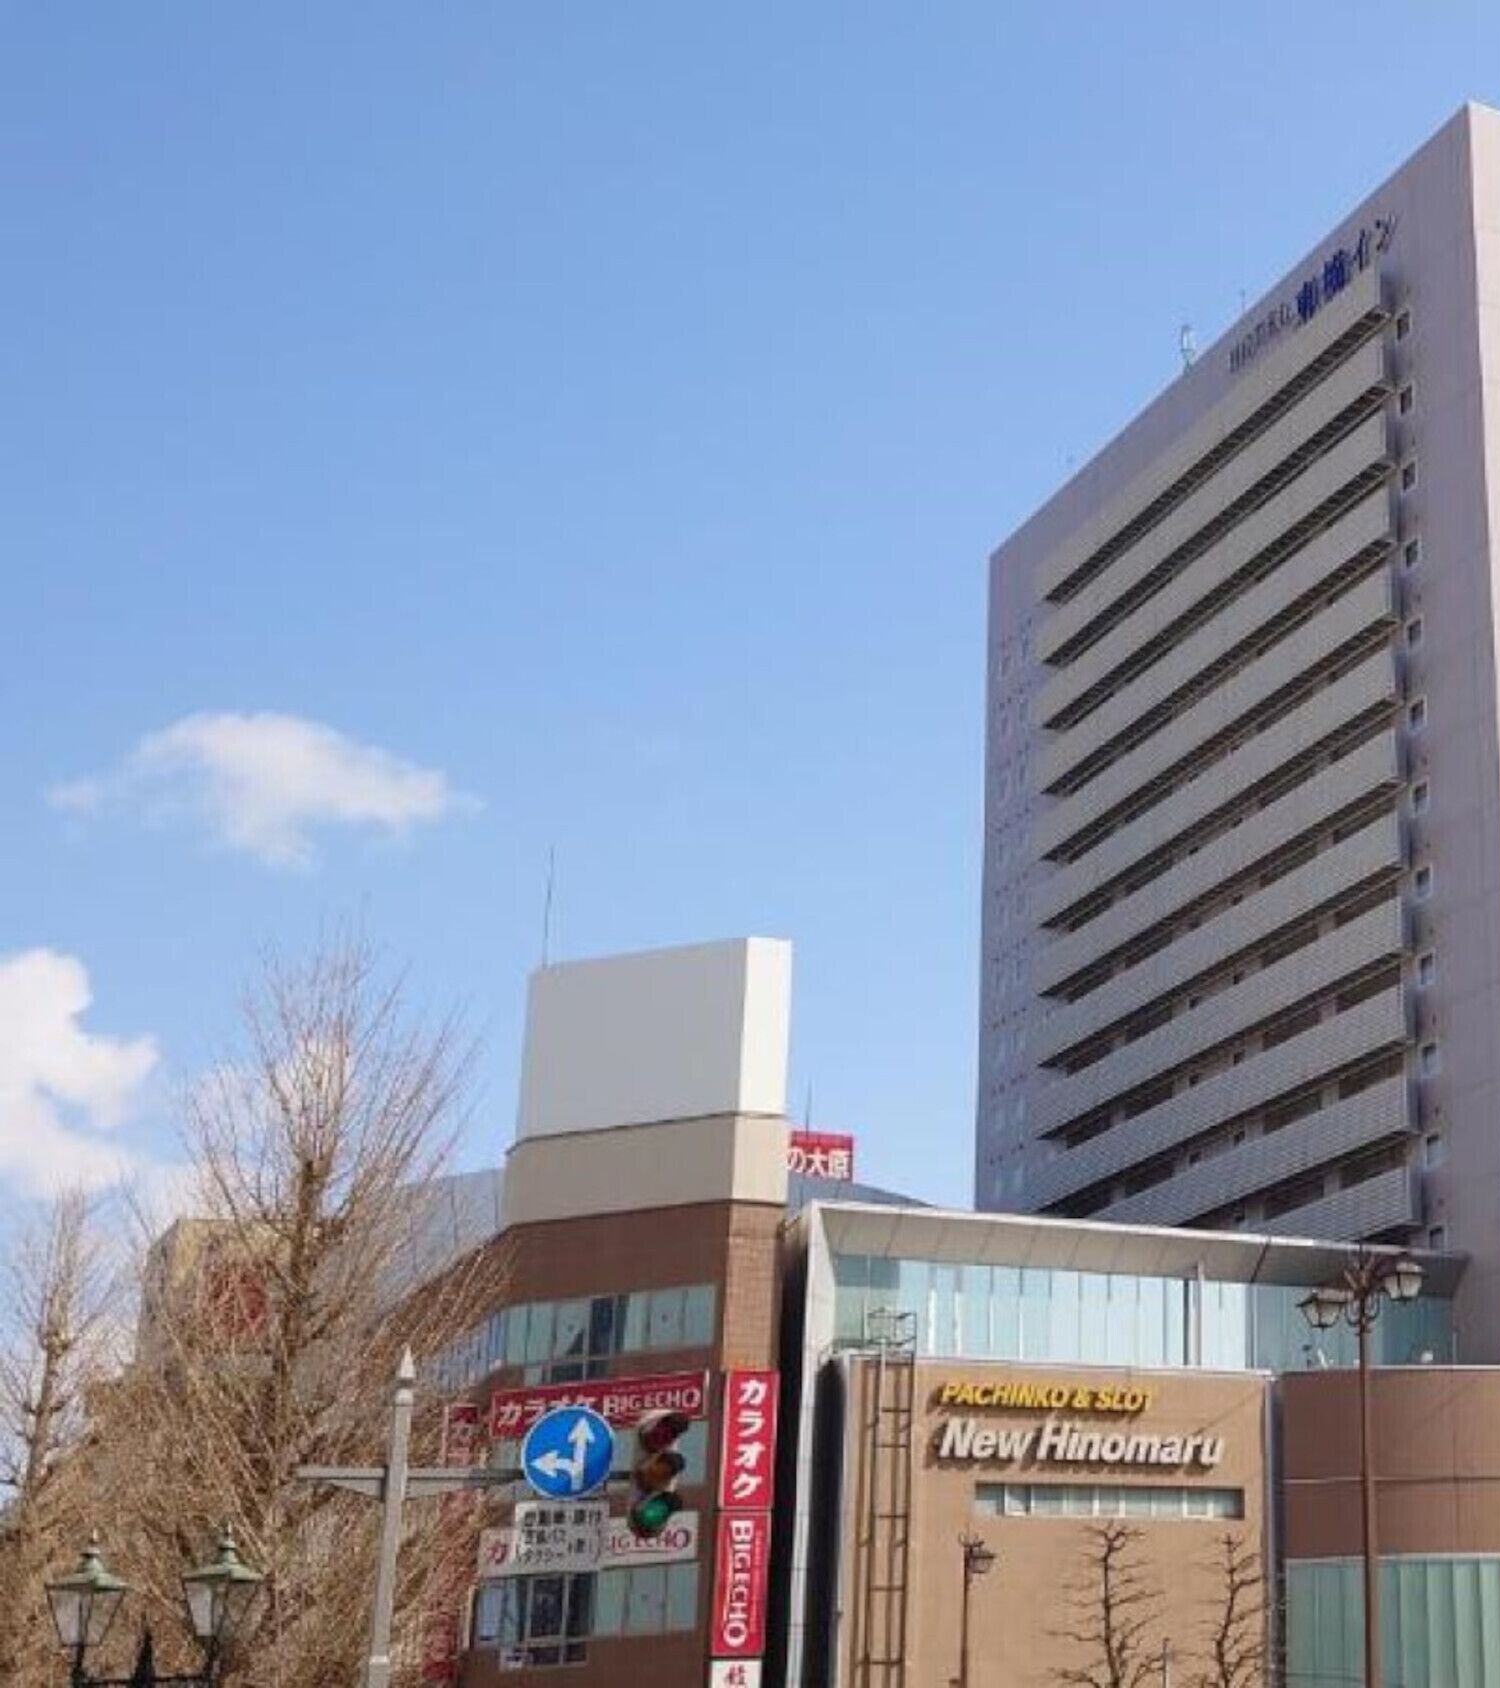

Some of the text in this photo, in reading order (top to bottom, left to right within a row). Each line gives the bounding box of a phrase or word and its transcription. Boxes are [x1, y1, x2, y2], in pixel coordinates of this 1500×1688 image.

[785, 1146, 850, 1179] の大原
[603, 1393, 641, 1416] BIG
[644, 1388, 700, 1409] ECHO
[941, 1382, 1152, 1411] PACHINKO & SLOT
[731, 1379, 767, 1498] カラオケ
[938, 1417, 1226, 1465] New Hinomaru
[730, 1520, 755, 1569] BIG
[723, 1572, 749, 1648] ECHO
